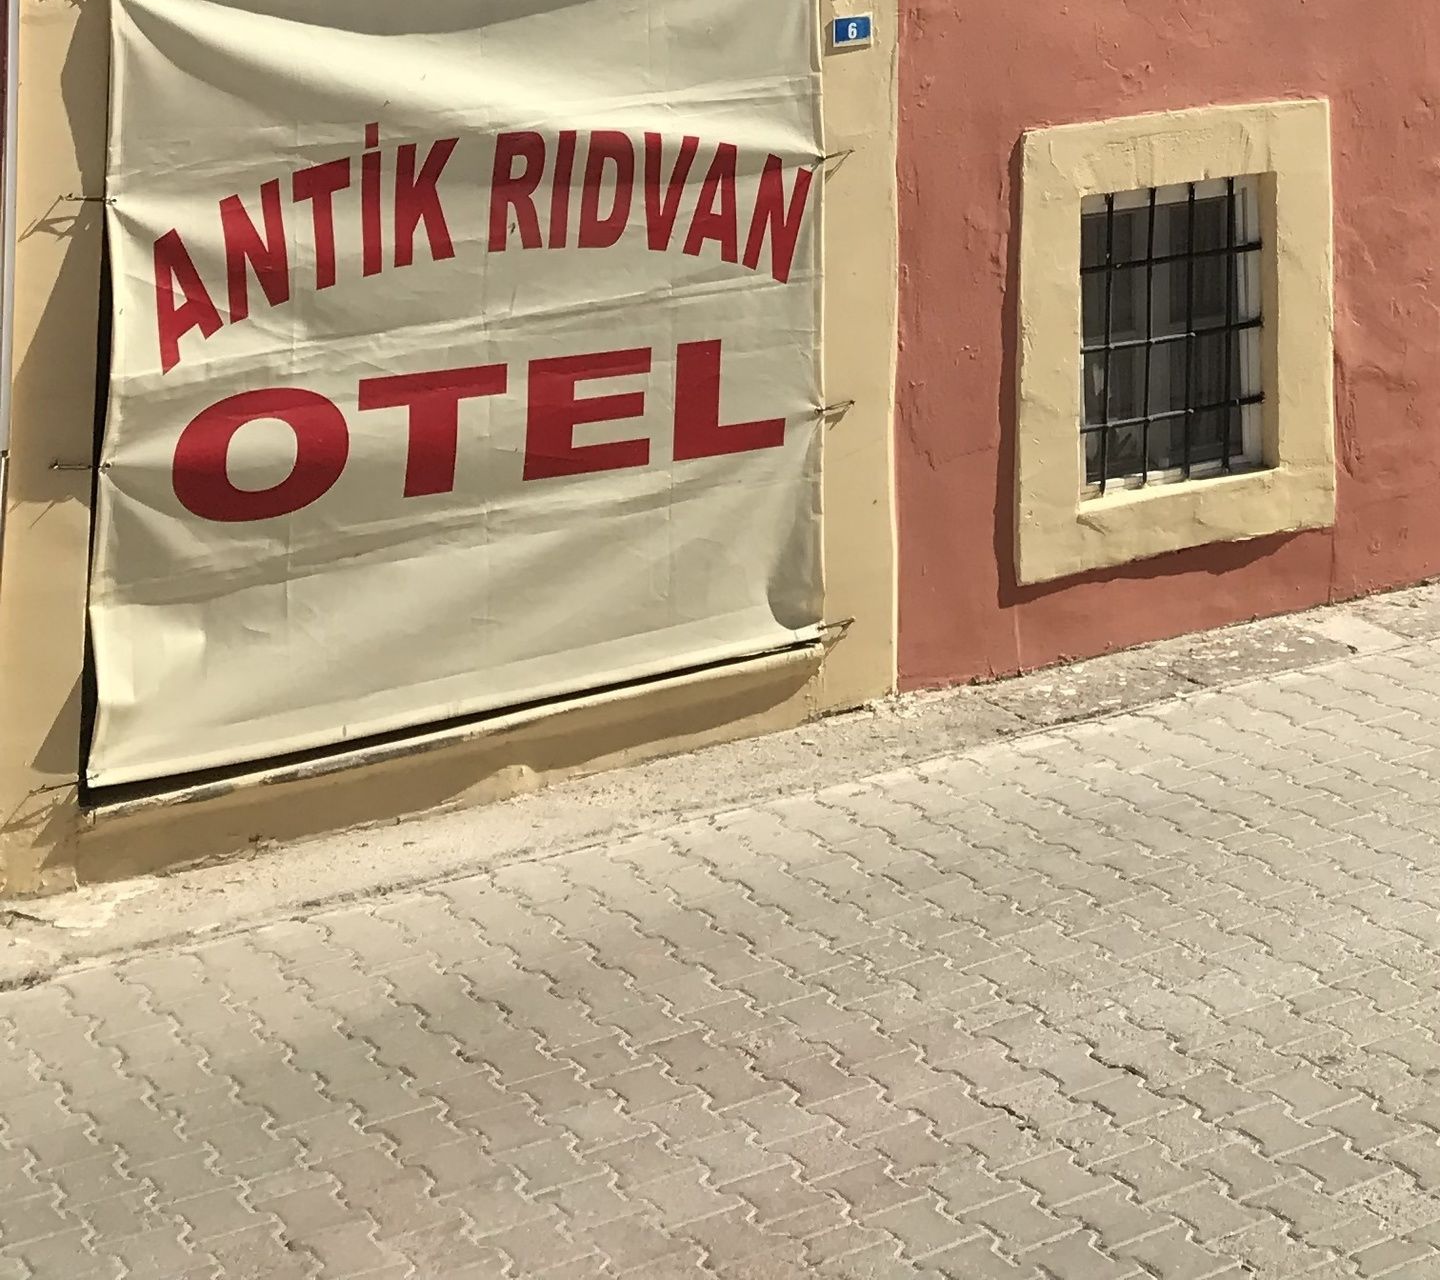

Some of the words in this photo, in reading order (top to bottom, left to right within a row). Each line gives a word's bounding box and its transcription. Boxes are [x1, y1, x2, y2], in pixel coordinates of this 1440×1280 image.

[848, 22, 857, 39] 6
[151, 122, 460, 374] ANTİK
[489, 130, 813, 284] RIDVAN
[171, 339, 785, 523] OTEL
